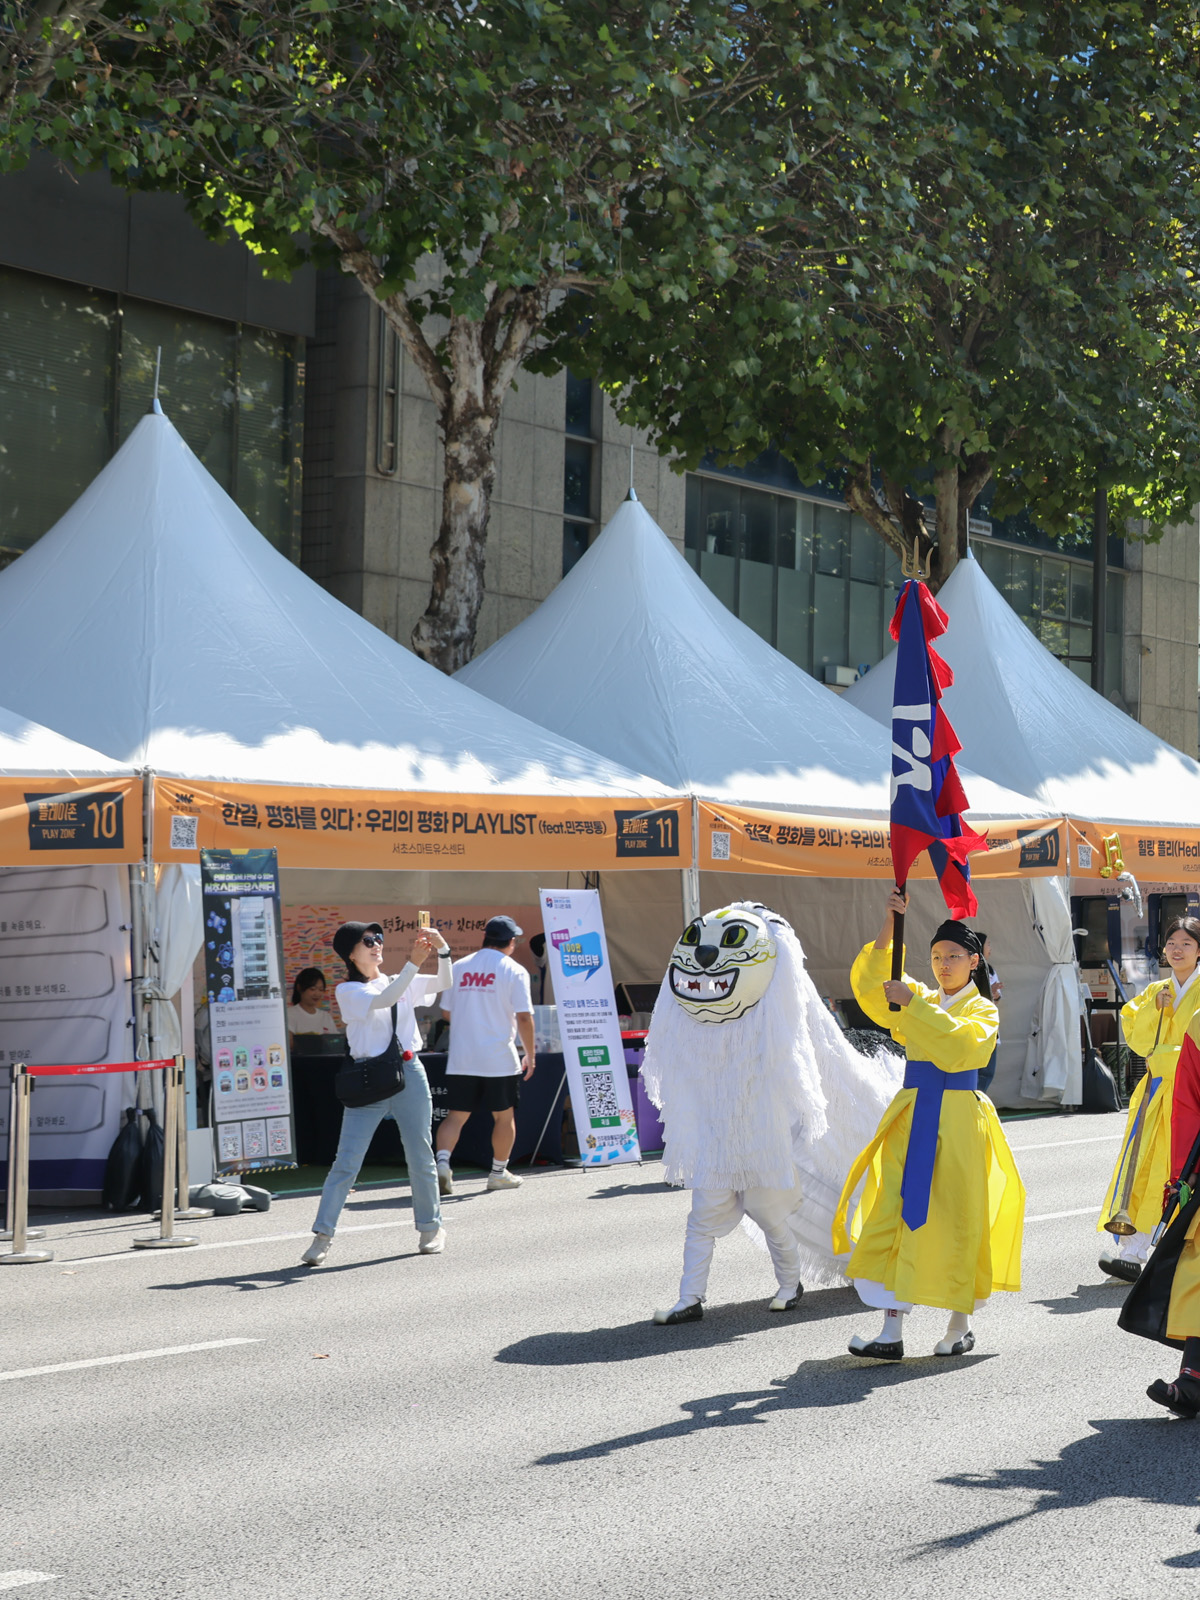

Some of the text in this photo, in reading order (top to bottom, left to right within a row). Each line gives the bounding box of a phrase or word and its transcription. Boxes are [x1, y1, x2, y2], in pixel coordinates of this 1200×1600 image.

[38, 802, 78, 821] 플레이존
[87, 801, 118, 839] 10
[222, 802, 262, 829] 한결,
[265, 805, 318, 830] 평화를
[320, 807, 354, 831] 잇다
[365, 809, 414, 833] 우리의
[417, 811, 450, 834] 평화
[452, 812, 537, 835] PLAYLIST
[539, 819, 607, 836] (feat.민주평통)
[42, 828, 76, 840] PLAY ZONE
[622, 818, 649, 834] 플레이존
[656, 817, 673, 848] 11
[624, 840, 648, 849] PLAY ZONE
[743, 822, 774, 845] 한결,
[775, 825, 816, 846] 평화를
[818, 828, 843, 848] 잇다
[850, 829, 886, 849] 우리의
[392, 843, 466, 855] 서초스마트유스센터
[1045, 835, 1056, 860] 11
[1138, 839, 1155, 857] 힐링
[562, 943, 582, 953] 100만
[563, 954, 600, 967] 국민인터뷰
